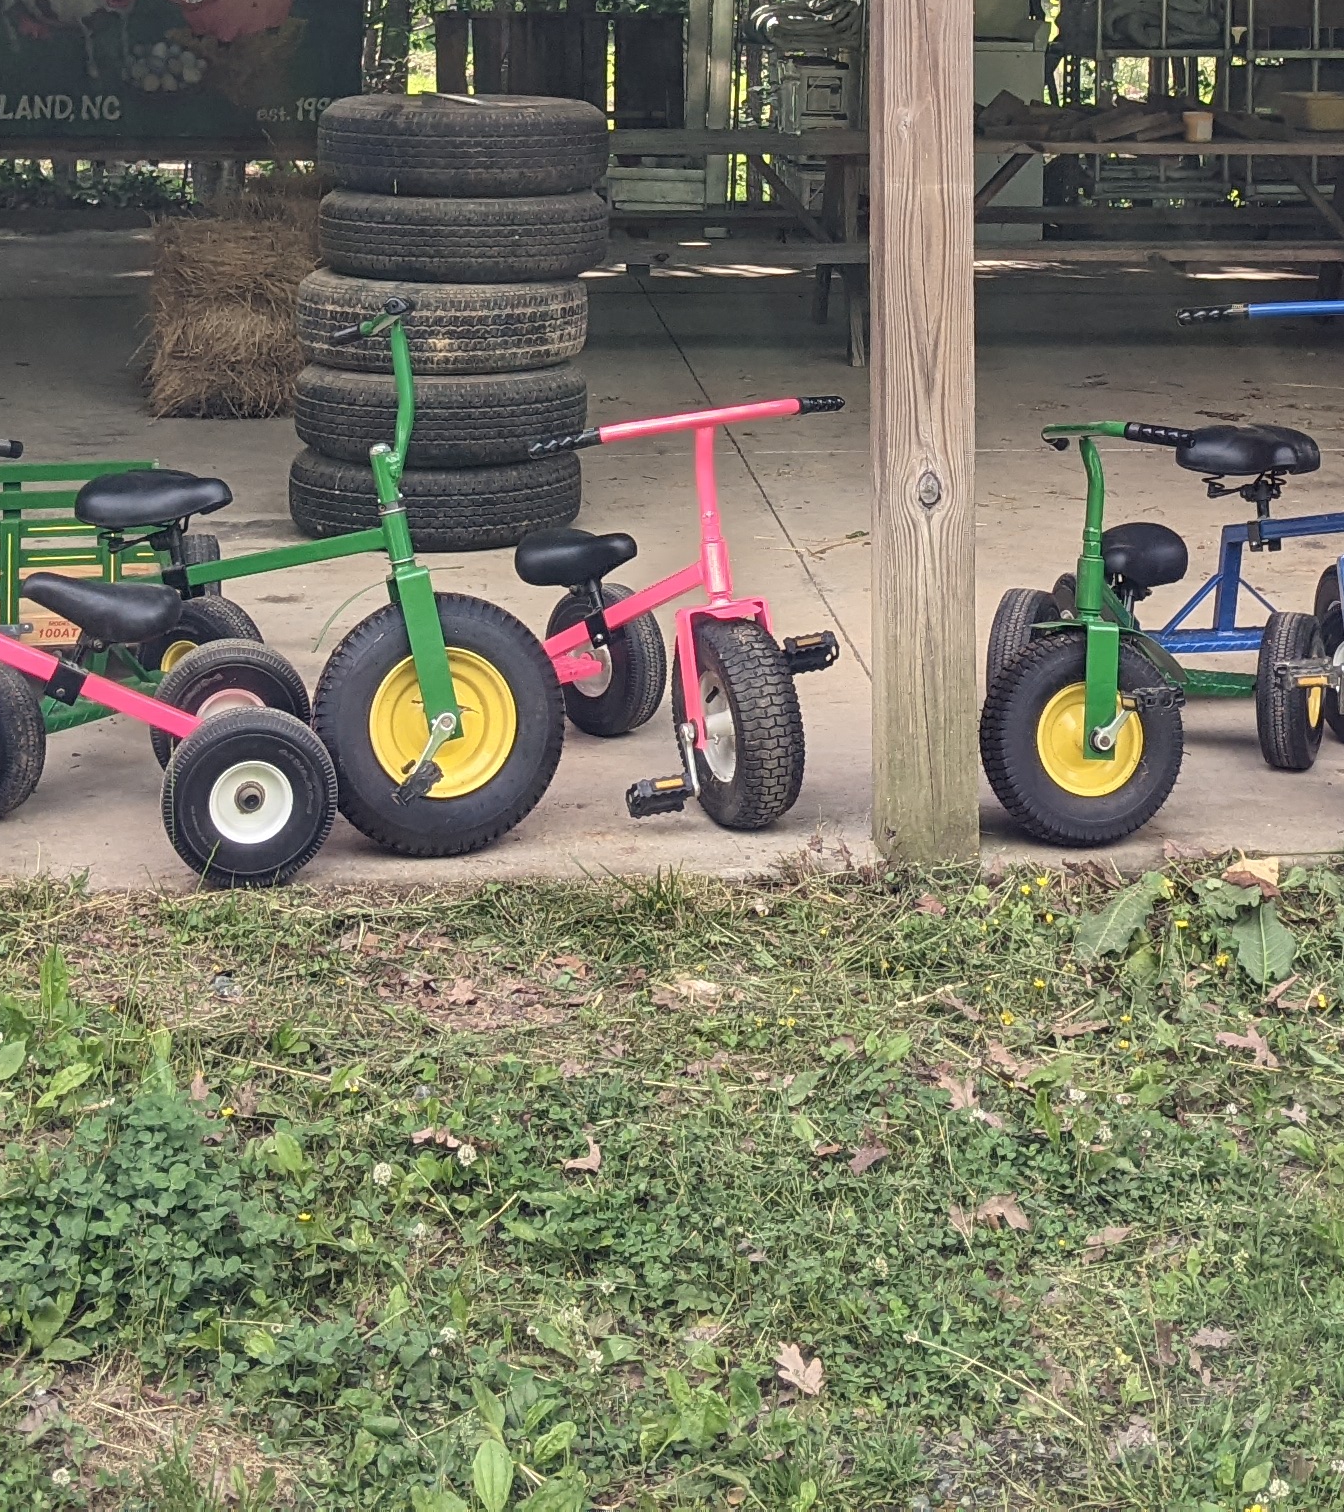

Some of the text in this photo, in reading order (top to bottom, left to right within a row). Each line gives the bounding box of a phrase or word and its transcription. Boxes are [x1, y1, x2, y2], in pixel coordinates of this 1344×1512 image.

[81, 94, 121, 121] NC
[256, 107, 291, 122] est.
[39, 628, 79, 639] 100AT
